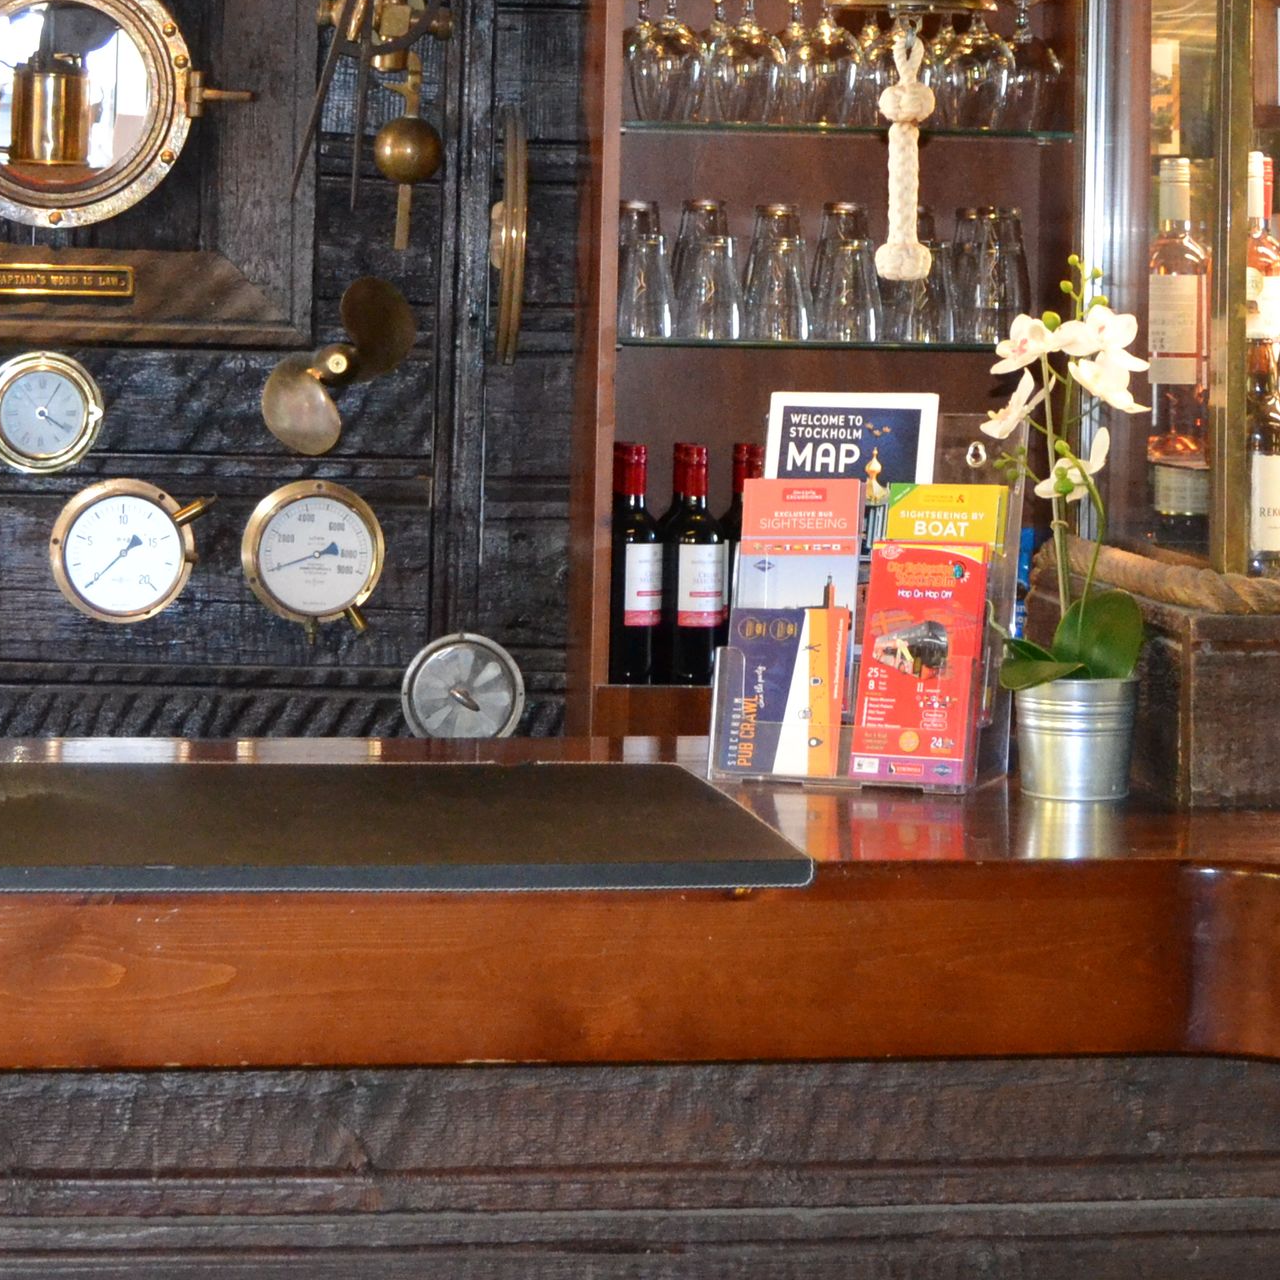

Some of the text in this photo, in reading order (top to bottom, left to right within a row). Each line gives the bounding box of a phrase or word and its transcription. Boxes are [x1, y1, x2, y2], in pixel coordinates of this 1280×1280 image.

[51, 275, 78, 286] WORD
[83, 276, 93, 286] IS
[790, 413, 863, 426] WELCOME TO
[789, 426, 862, 440] STOCKHOLM
[786, 441, 861, 473] MAP
[119, 515, 128, 525] 10
[900, 510, 985, 521] SIGHTSEEING BY
[759, 518, 848, 529] SIGHTSEEING
[913, 521, 969, 537] BOAT
[87, 536, 93, 546] 5
[149, 538, 157, 548] 15
[139, 575, 150, 584] 20
[898, 589, 953, 599] Hop On Hop Off
[867, 667, 879, 678] 25
[868, 680, 875, 690] 8
[728, 697, 743, 766] STOCKHOLM
[737, 694, 759, 767] PUB CRAWL
[930, 737, 943, 748] 24
